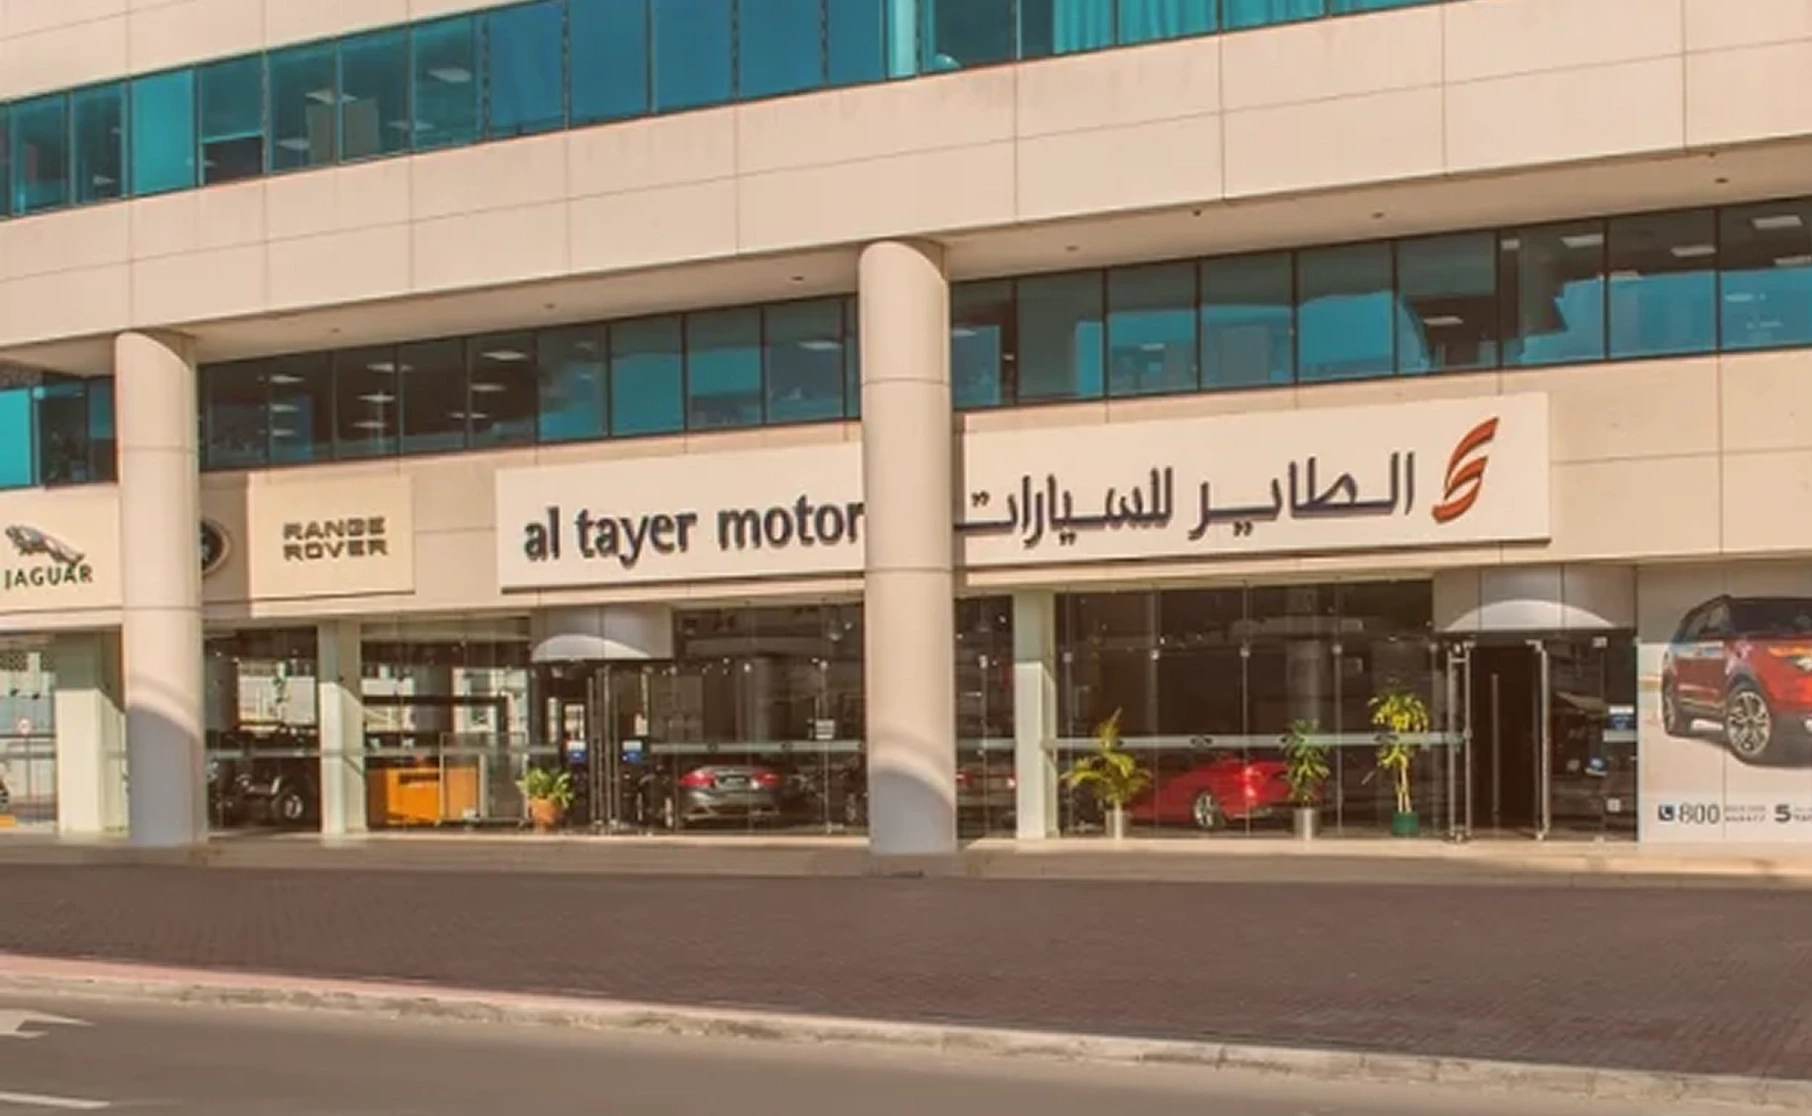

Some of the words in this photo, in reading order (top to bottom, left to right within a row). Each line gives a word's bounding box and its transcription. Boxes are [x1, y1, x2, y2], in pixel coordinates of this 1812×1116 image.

[283, 517, 386, 540] RANGE
[525, 506, 560, 560] al
[575, 508, 698, 568] tayer
[718, 495, 865, 550] motor
[283, 540, 388, 561] ROVER
[4, 564, 93, 590] JAGUAR
